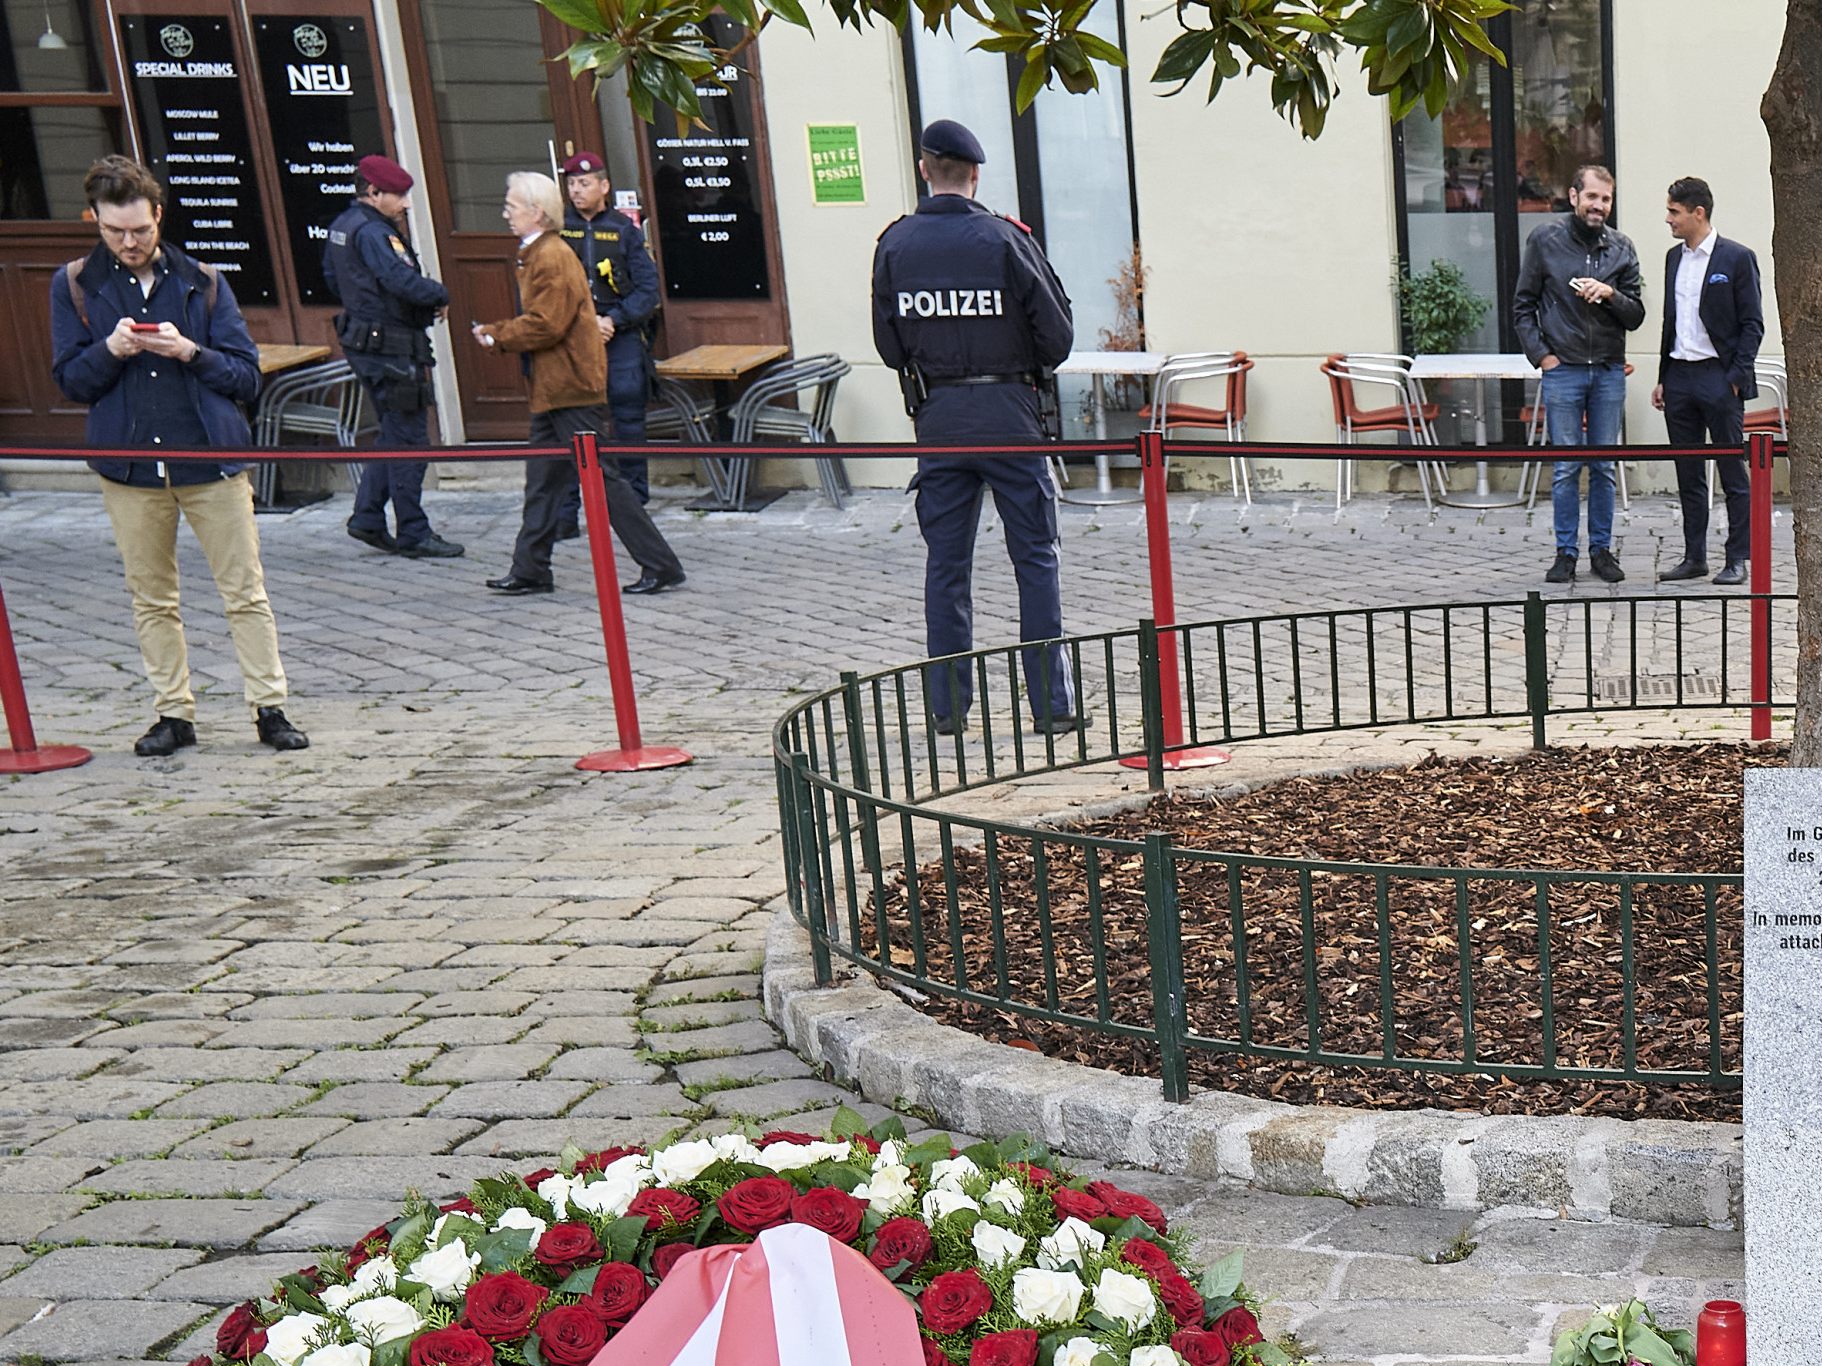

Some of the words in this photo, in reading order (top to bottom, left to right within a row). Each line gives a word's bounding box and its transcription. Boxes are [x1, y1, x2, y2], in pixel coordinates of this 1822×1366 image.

[135, 62, 186, 76] SPECIAL
[187, 62, 234, 76] DRINKS
[287, 64, 351, 91] NEU
[308, 142, 325, 152] Wir
[325, 142, 354, 152] haben
[813, 147, 857, 166] BITTE
[289, 163, 311, 174] über
[311, 163, 325, 174] 20
[816, 164, 861, 182] PSSST!
[897, 289, 1003, 317] POLIZEI
[1787, 826, 1805, 841] Im
[1788, 848, 1815, 863] des
[1752, 911, 1767, 926] In
